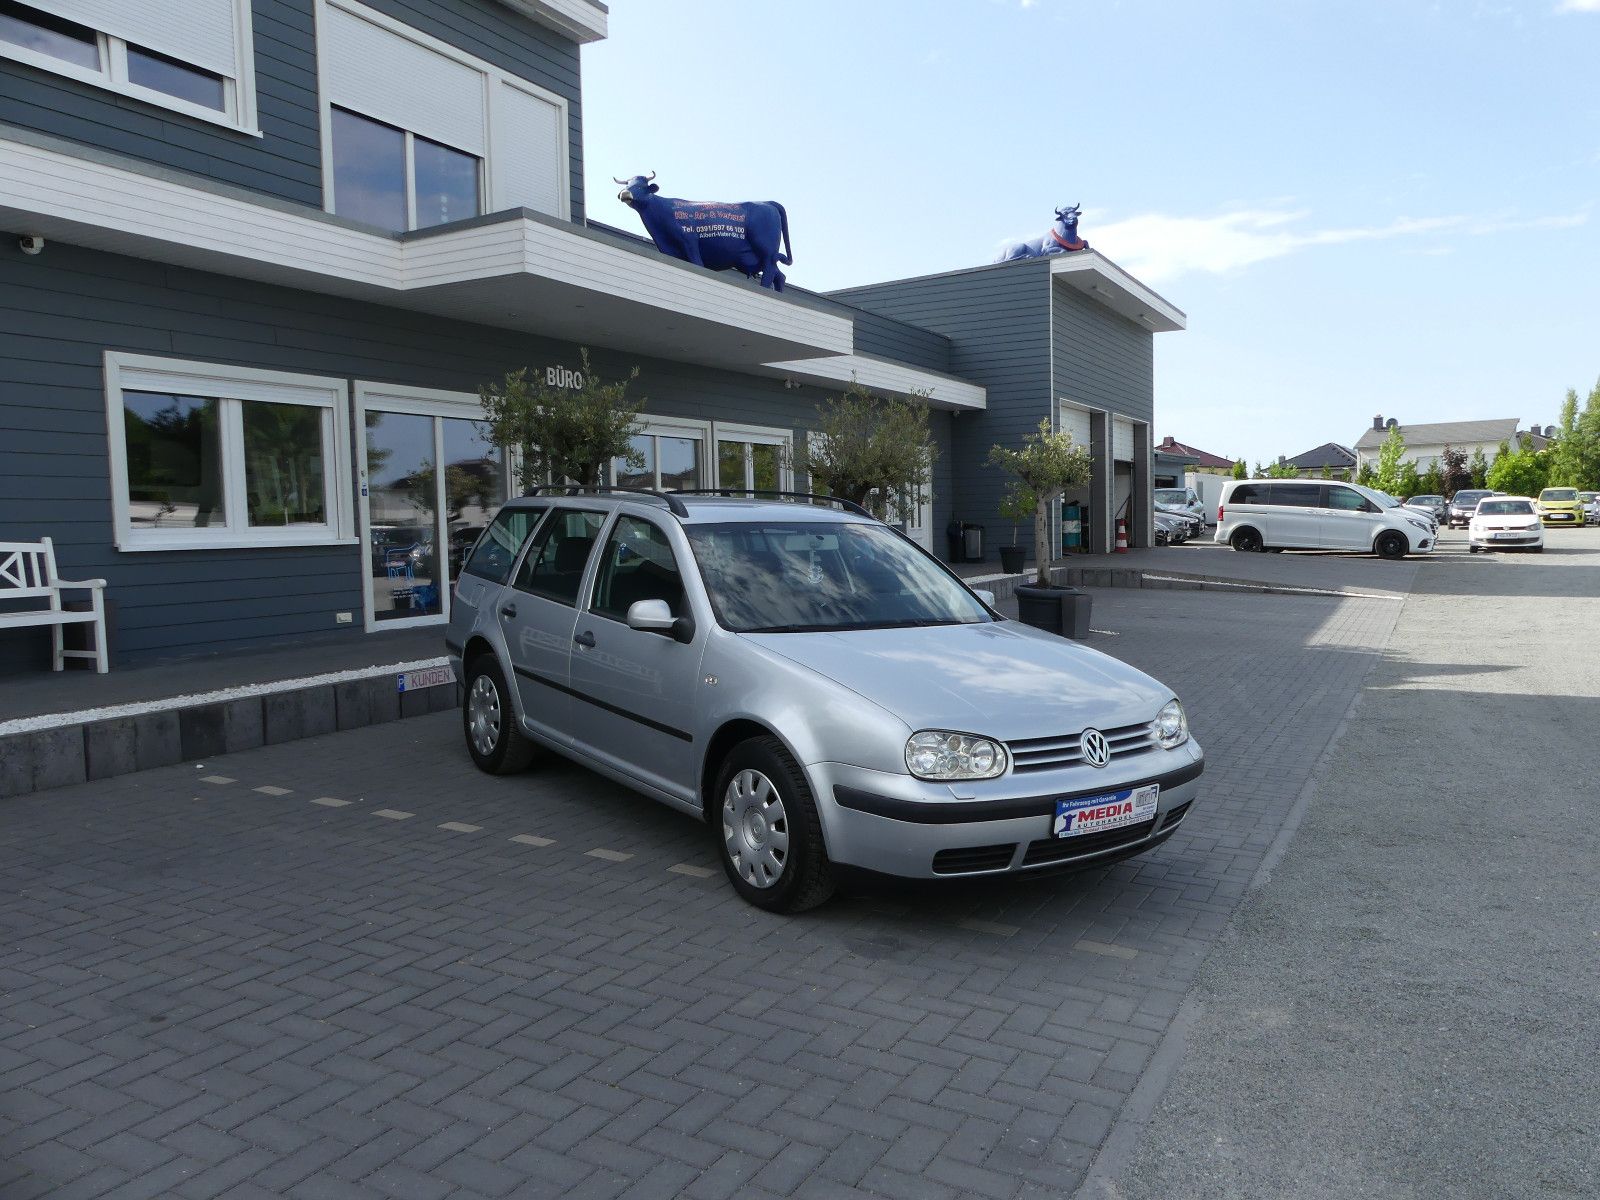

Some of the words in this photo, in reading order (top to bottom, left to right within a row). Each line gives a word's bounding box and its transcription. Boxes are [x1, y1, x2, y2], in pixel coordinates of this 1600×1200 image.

[682, 225, 695, 233] Tel.
[546, 365, 583, 390] BÜRO
[398, 678, 404, 688] P
[411, 669, 450, 688] KUNDEN
[1078, 802, 1133, 822] MEDIA
